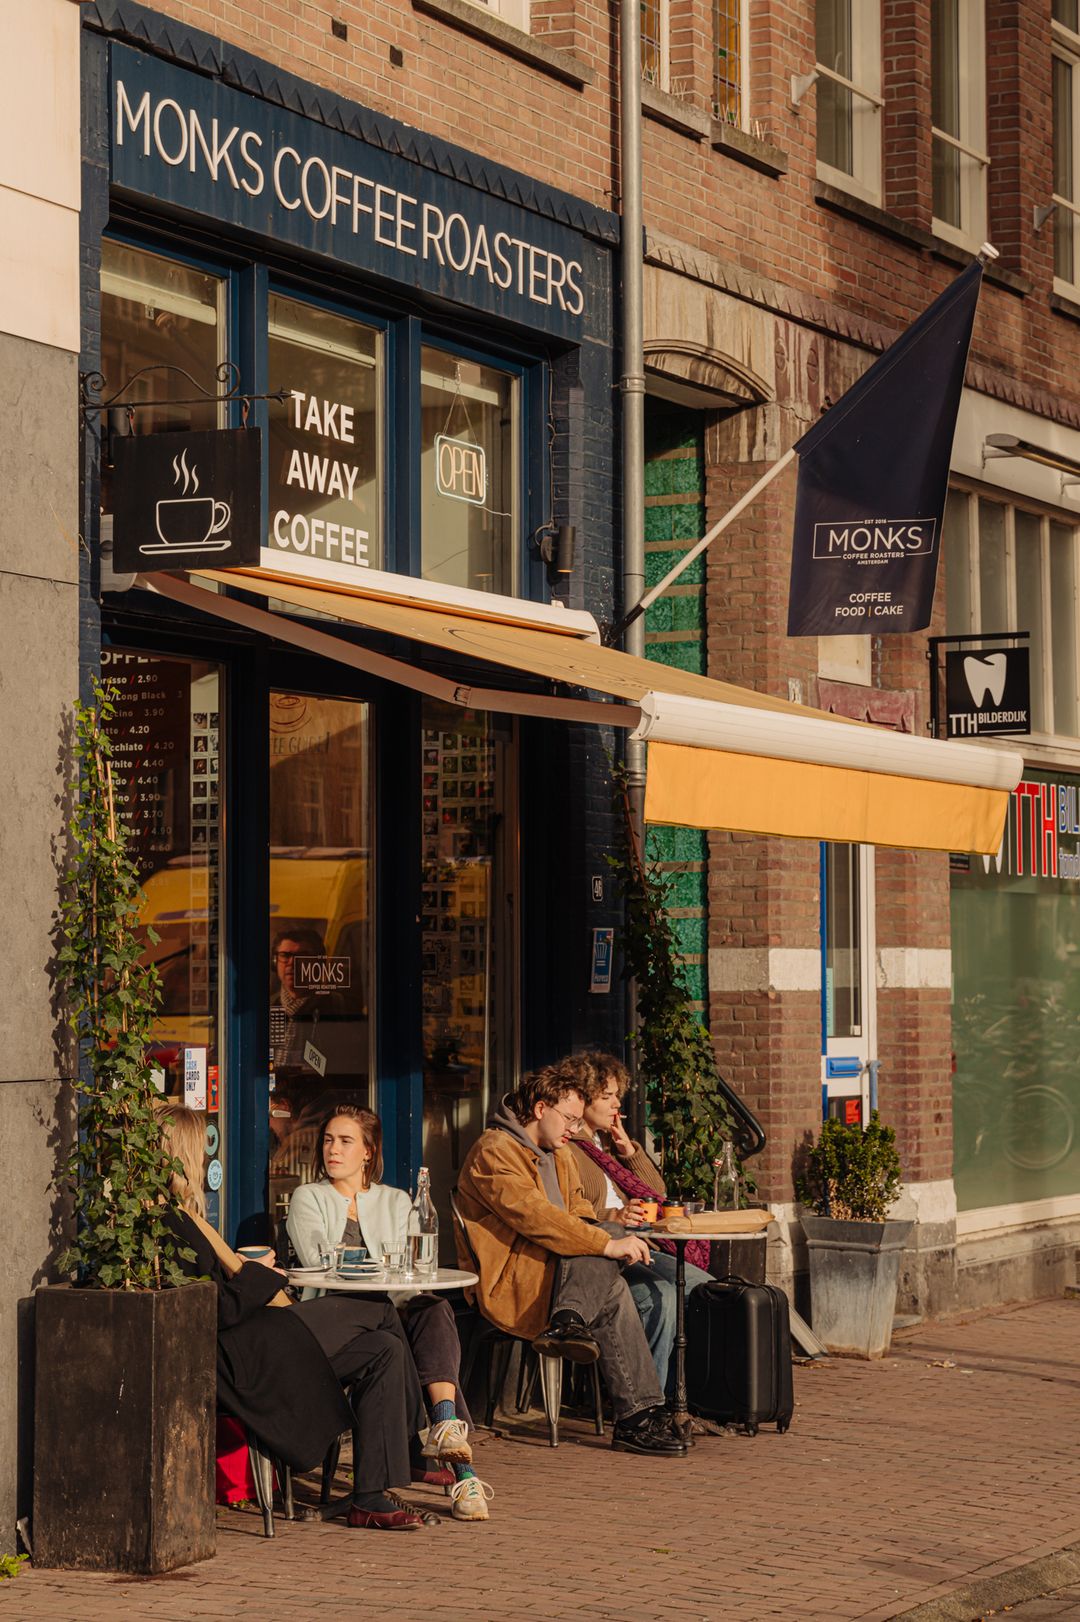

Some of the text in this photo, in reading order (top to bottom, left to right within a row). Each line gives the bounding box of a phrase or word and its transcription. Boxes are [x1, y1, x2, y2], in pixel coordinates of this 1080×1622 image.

[116, 80, 584, 316] MONKS COFFEE ROASTERS
[290, 389, 355, 444] TAKE
[286, 449, 359, 501] AWAY
[439, 443, 484, 498] OPEN
[273, 510, 369, 567] COFFEE
[829, 526, 923, 552] MONKS
[843, 551, 905, 560] COFFEE ROASTERS
[849, 592, 892, 603] COFFEE
[835, 605, 904, 617] FOOD CAKE
[137, 674, 158, 683] 2.90
[129, 725, 150, 734] 4.20
[950, 711, 1027, 734] TTH BILDERDIJK
[142, 760, 164, 768] 4.40
[138, 776, 159, 784] 4.40
[140, 793, 161, 801] 3.90
[1058, 785, 1080, 834] BIL
[301, 962, 344, 983] MONKS
[308, 1048, 321, 1069] OPEN
[186, 1070, 200, 1081] CARDS
[186, 1081, 196, 1092] ONLY
